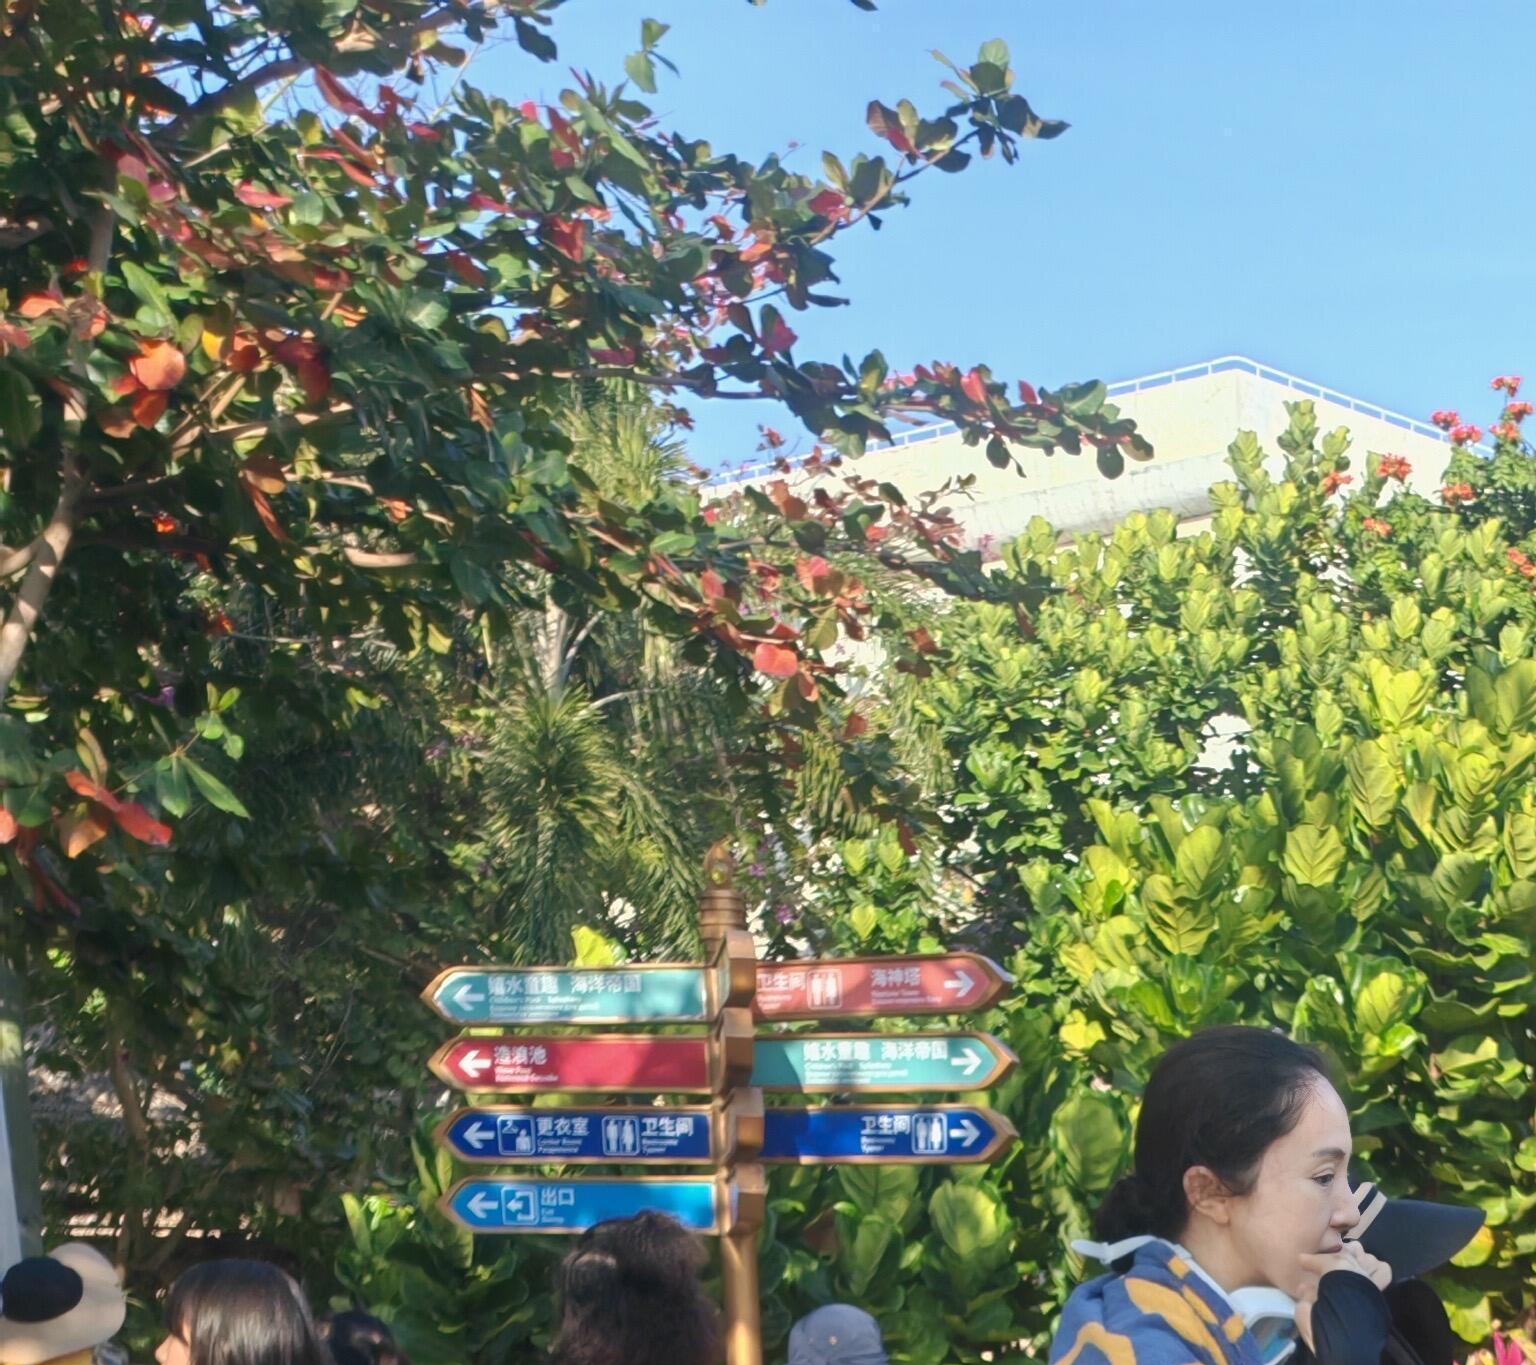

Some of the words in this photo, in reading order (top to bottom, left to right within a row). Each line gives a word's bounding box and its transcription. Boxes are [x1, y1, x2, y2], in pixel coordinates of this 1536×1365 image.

[570, 973, 642, 994] 海洋帝国
[757, 971, 806, 992] 卫生间
[871, 967, 921, 987] 海神塔
[881, 1040, 948, 1061] 海洋帝国
[536, 1116, 590, 1136] 更衣室
[641, 1116, 694, 1137] 卫生间
[860, 1115, 911, 1136] 卫生间
[541, 1187, 575, 1206] 出口
